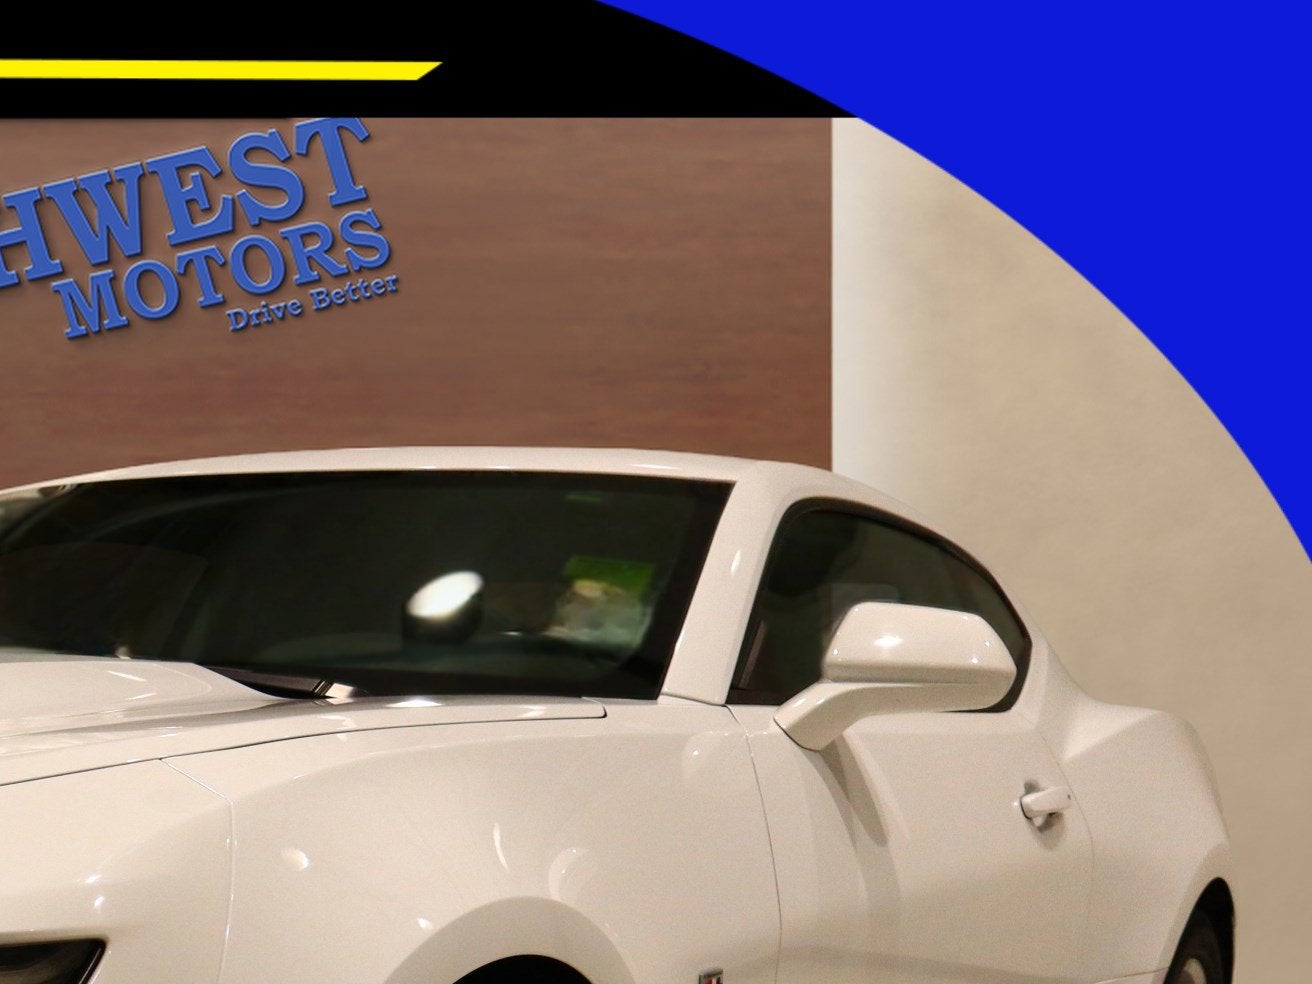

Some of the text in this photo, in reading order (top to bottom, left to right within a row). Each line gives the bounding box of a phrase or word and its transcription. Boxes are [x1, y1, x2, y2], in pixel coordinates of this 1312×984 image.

[51, 209, 391, 339] MOTORS
[226, 275, 399, 331] Drive Better
